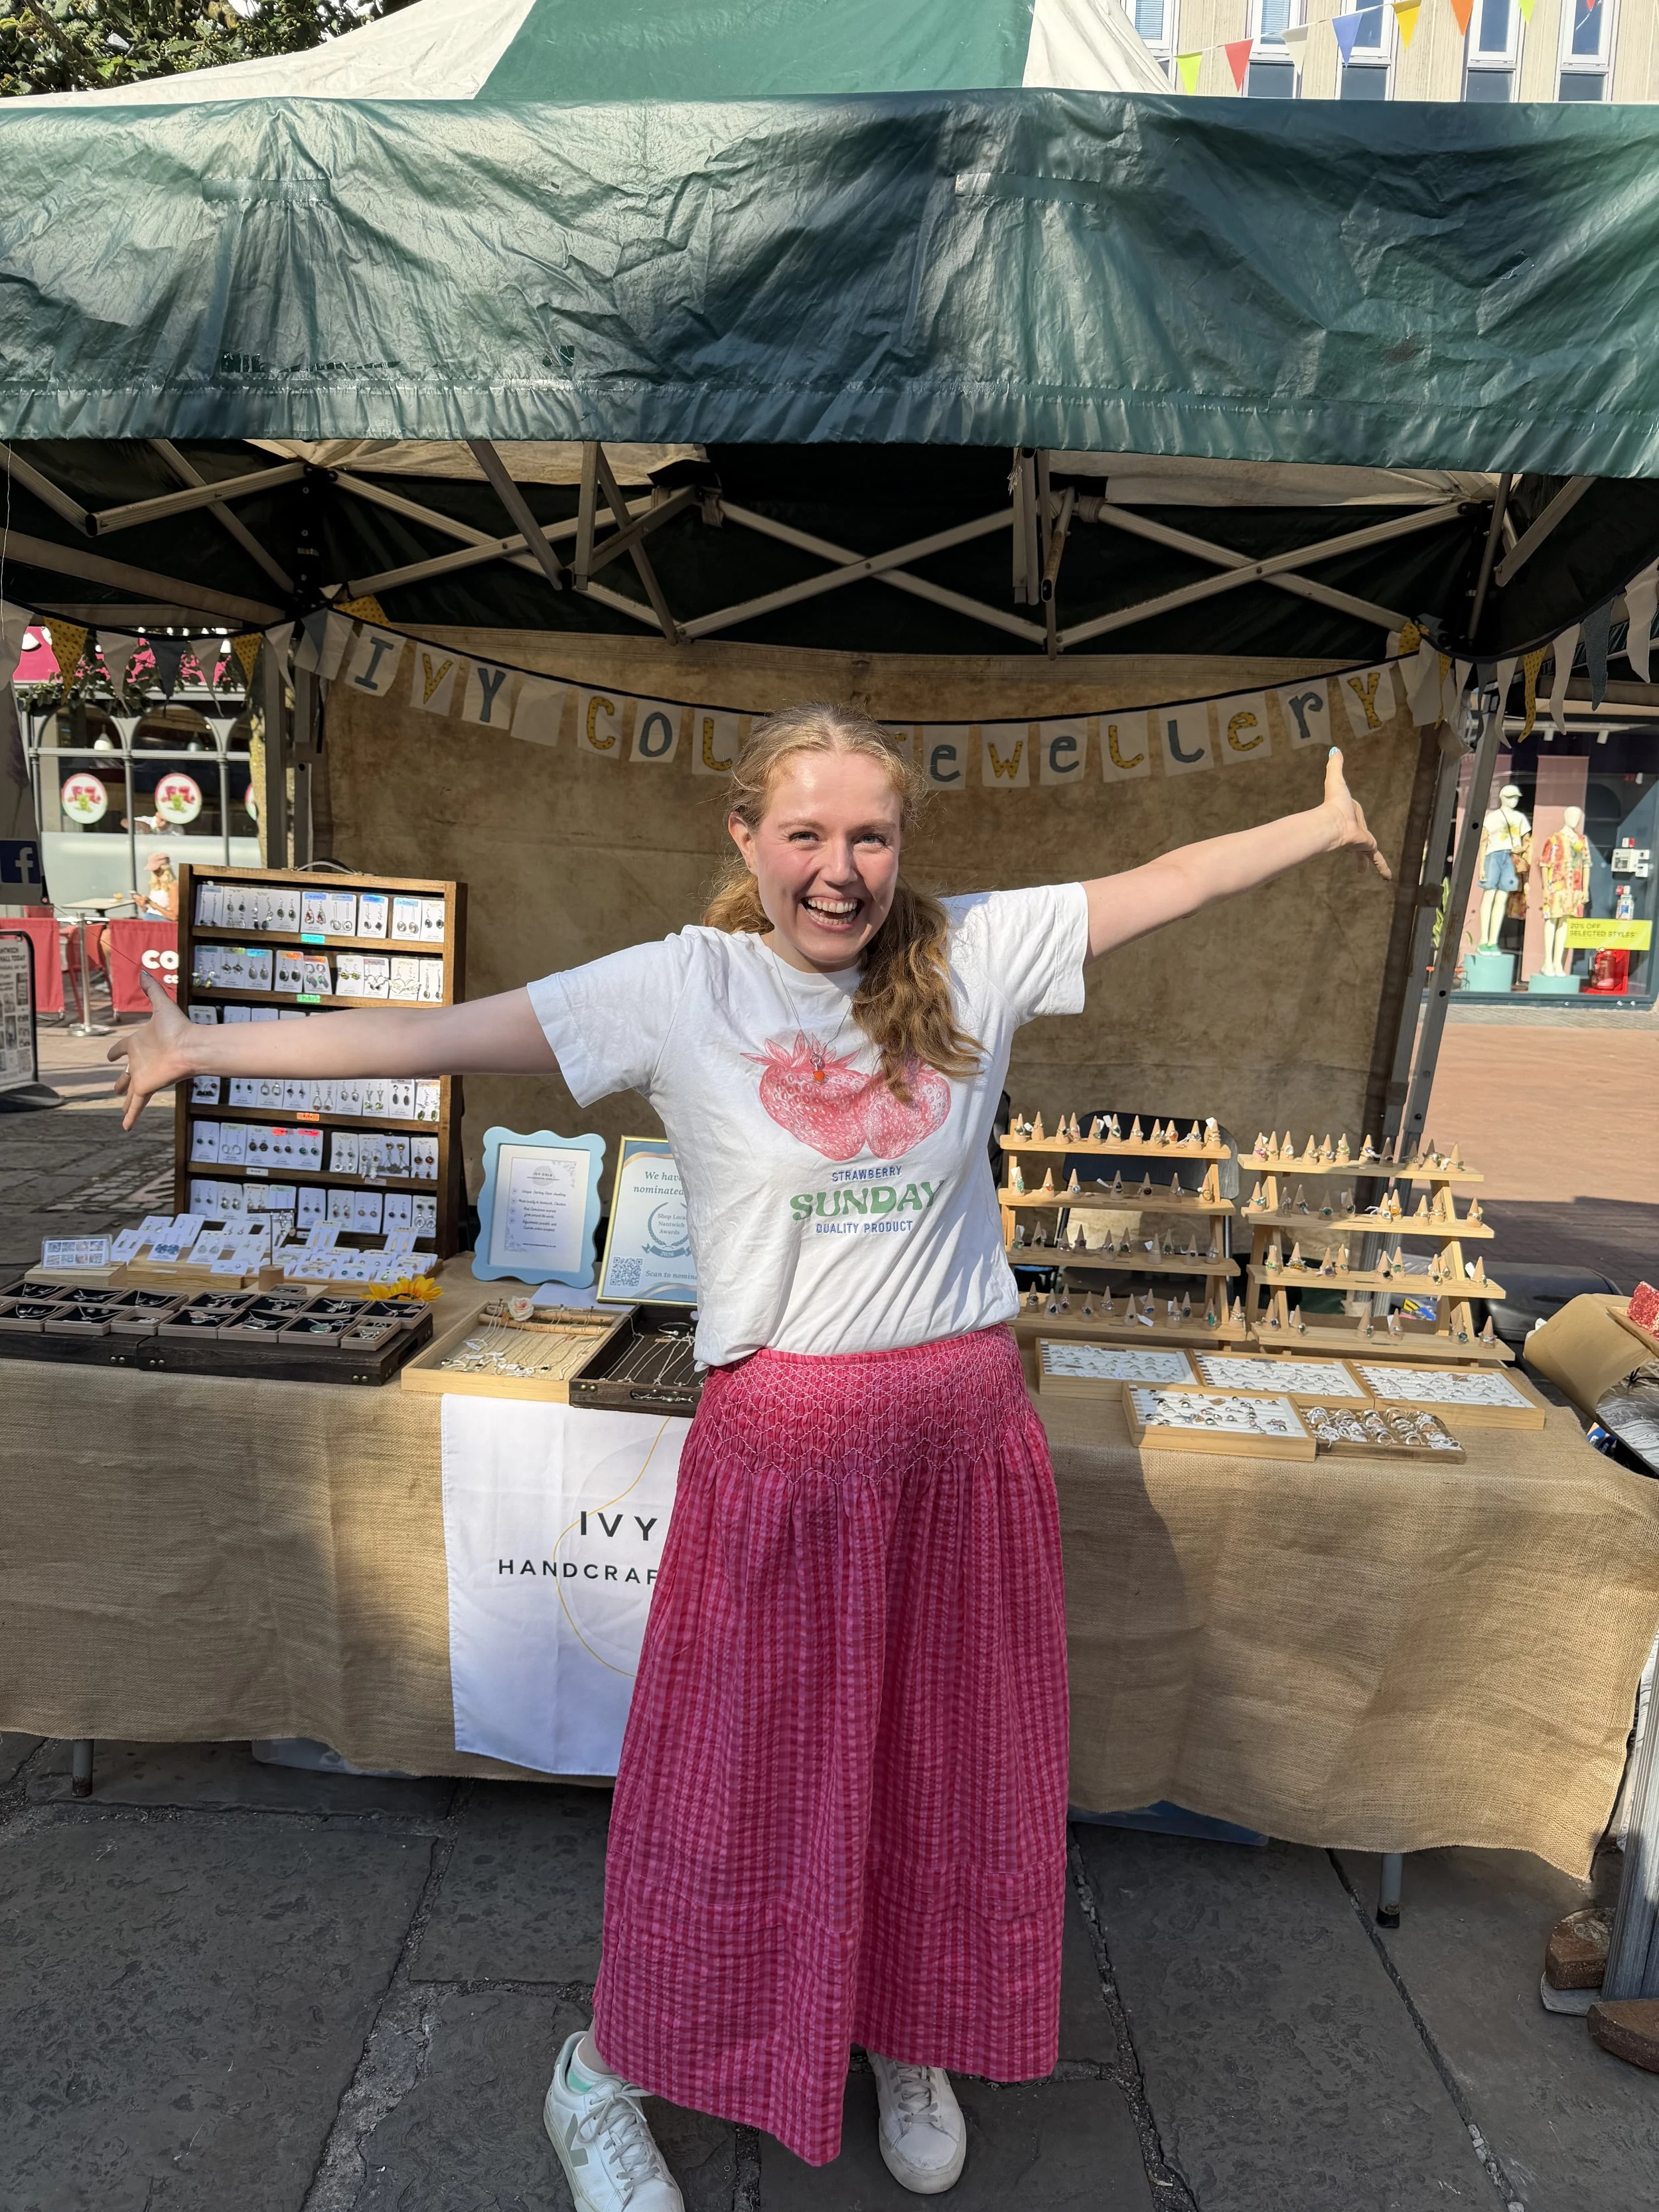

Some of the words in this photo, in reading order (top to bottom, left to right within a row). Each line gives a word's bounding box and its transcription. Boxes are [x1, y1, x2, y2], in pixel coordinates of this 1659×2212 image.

[354, 636, 506, 723] IVY
[587, 696, 733, 772] COL
[141, 949, 179, 970] CO
[645, 1171, 659, 1180] We
[831, 1165, 902, 1182] STRAWBERRY
[790, 1179, 945, 1221] SUNDAY
[816, 1223, 859, 1234] QUALITY
[864, 1220, 913, 1233] PRODUCT
[581, 1511, 658, 1542] IVY
[499, 1559, 659, 1585] HANDCRAF
